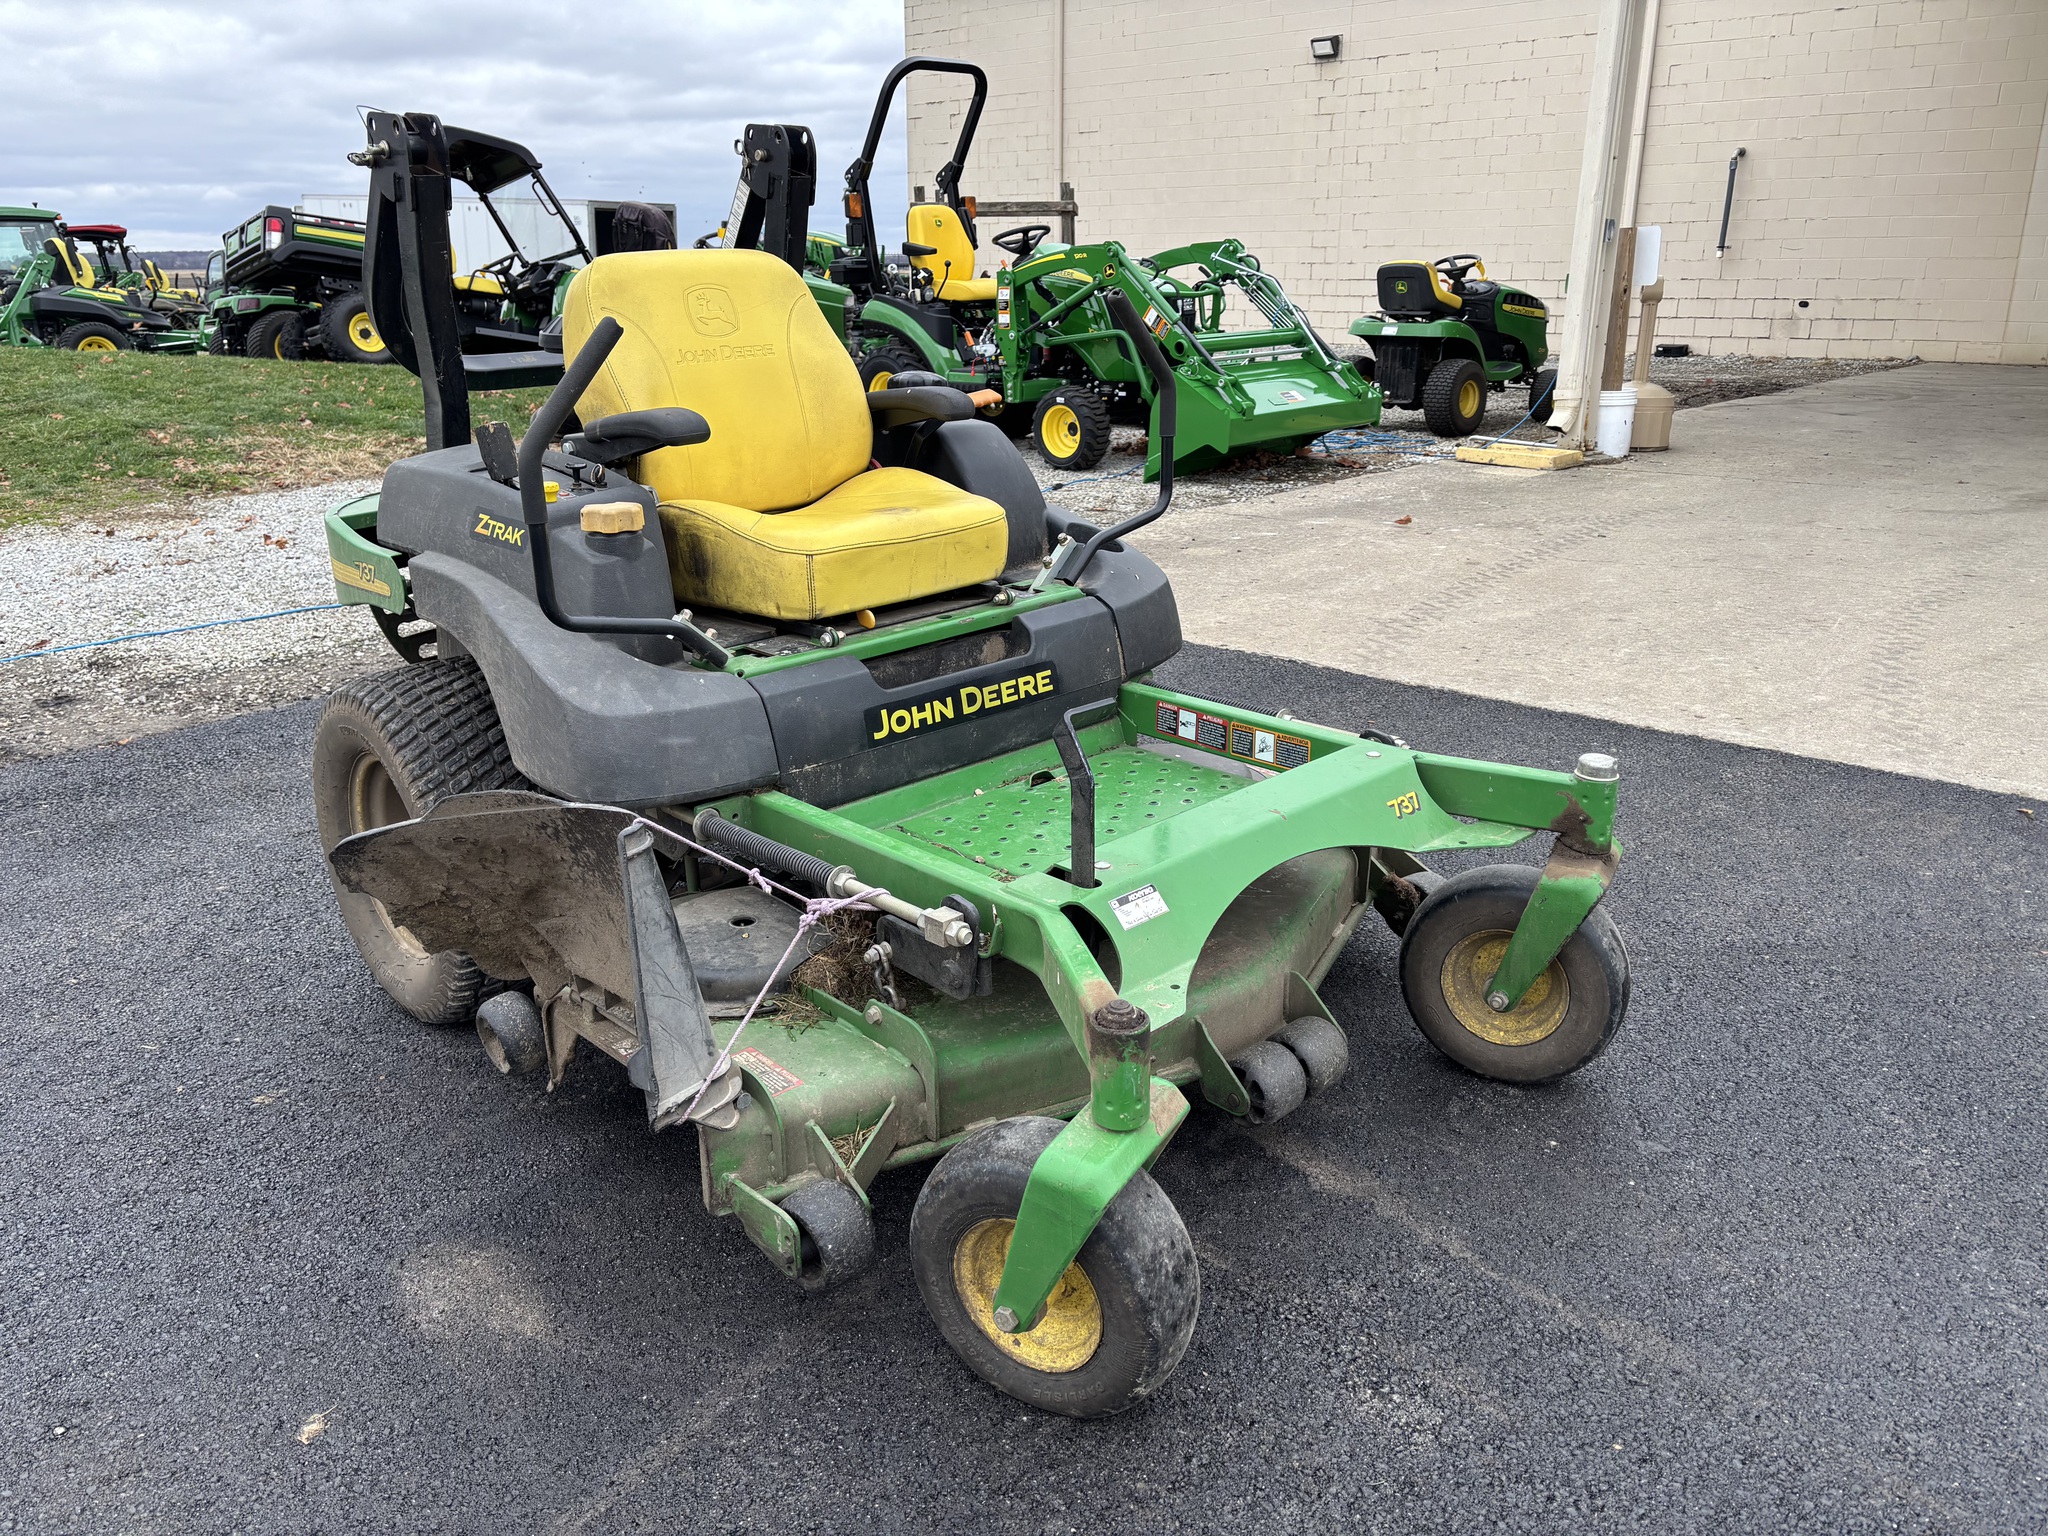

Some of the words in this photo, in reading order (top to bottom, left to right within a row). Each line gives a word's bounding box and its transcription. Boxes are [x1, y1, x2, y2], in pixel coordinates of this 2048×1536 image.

[1522, 308, 1536, 316] DEERE
[677, 348, 719, 366] JOHN
[719, 344, 775, 361] DEERE
[474, 513, 526, 547] ZTRAK
[353, 561, 375, 584] 737
[873, 696, 955, 740] JOHN
[959, 669, 1054, 715] DEERE
[1162, 702, 1178, 711] DANGER
[1206, 714, 1224, 725] PELIGRO
[1235, 722, 1254, 733] WARNING
[1386, 791, 1421, 819] 737
[1033, 1381, 1105, 1403] CARLISLE
